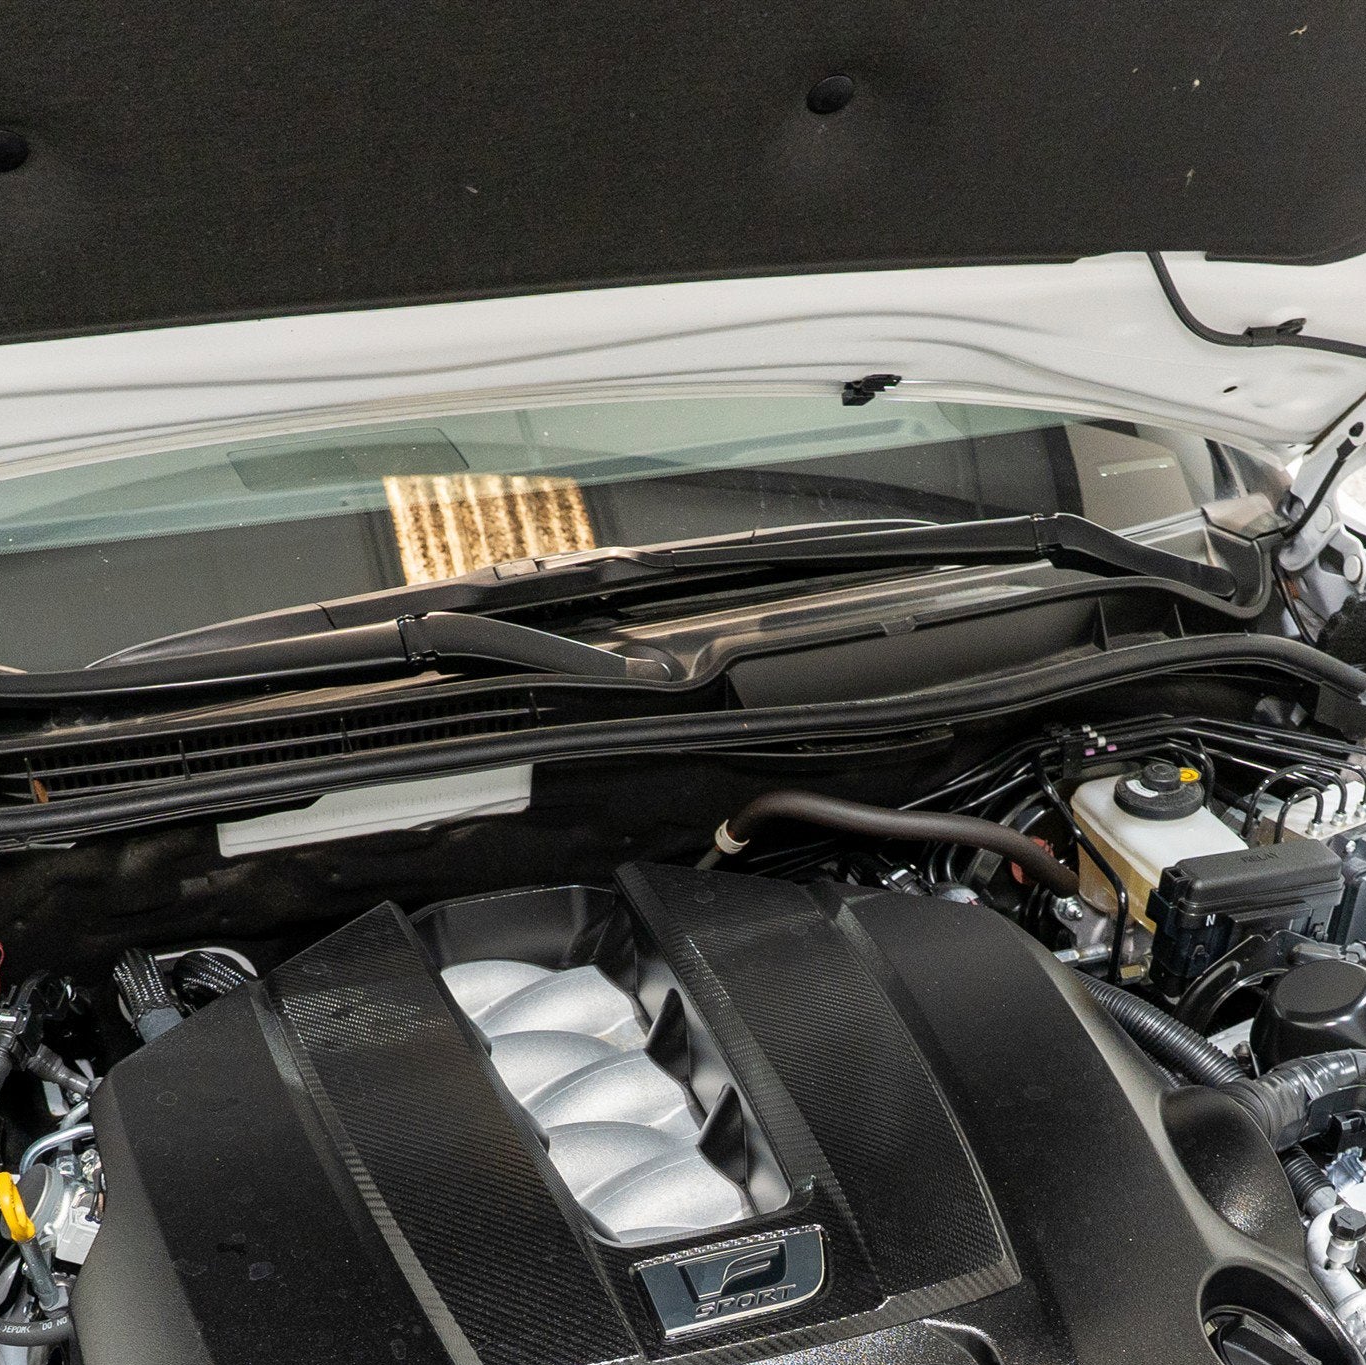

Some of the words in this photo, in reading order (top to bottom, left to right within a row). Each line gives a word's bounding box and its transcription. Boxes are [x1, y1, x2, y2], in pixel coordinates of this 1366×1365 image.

[1205, 914, 1217, 927] N
[694, 1283, 797, 1319] SPORT
[41, 1321, 53, 1331] DO
